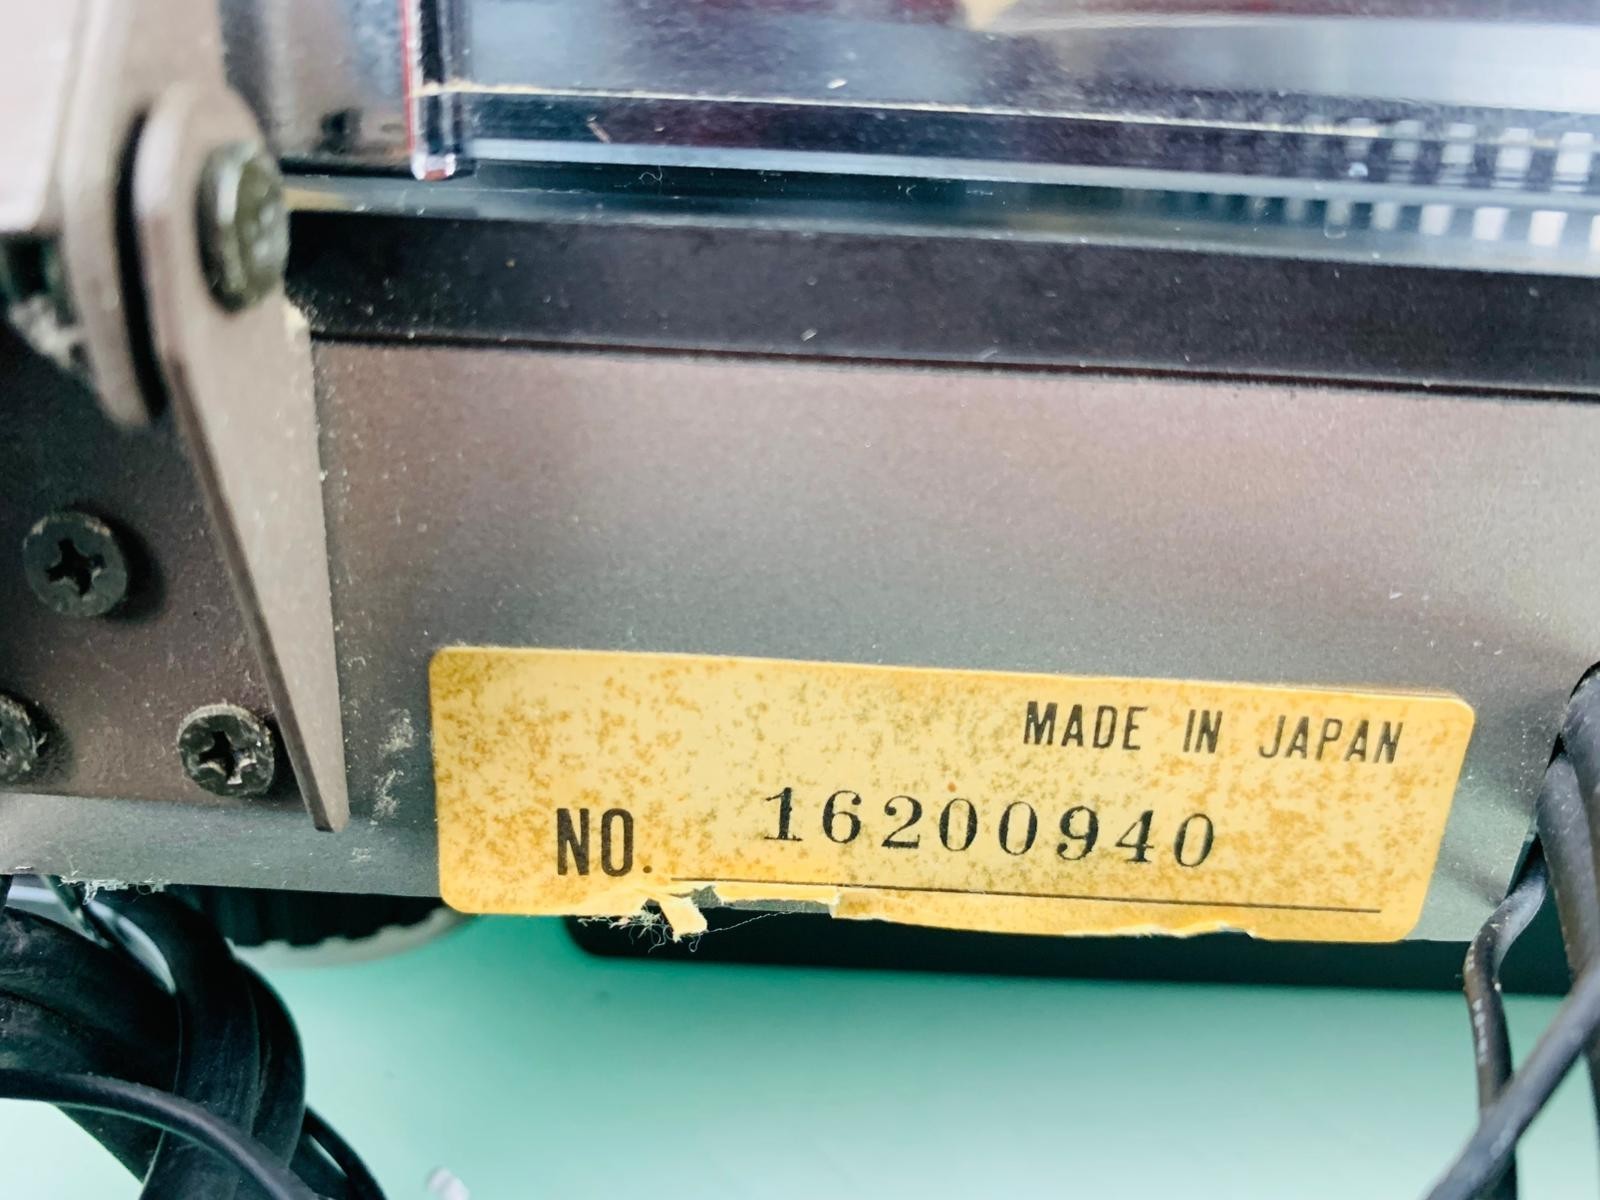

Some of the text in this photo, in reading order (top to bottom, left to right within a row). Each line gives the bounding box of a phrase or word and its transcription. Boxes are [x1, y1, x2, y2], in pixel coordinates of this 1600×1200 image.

[1023, 701, 1405, 764] MADE IN JAPAN
[556, 786, 1215, 877] NO. 16200940
